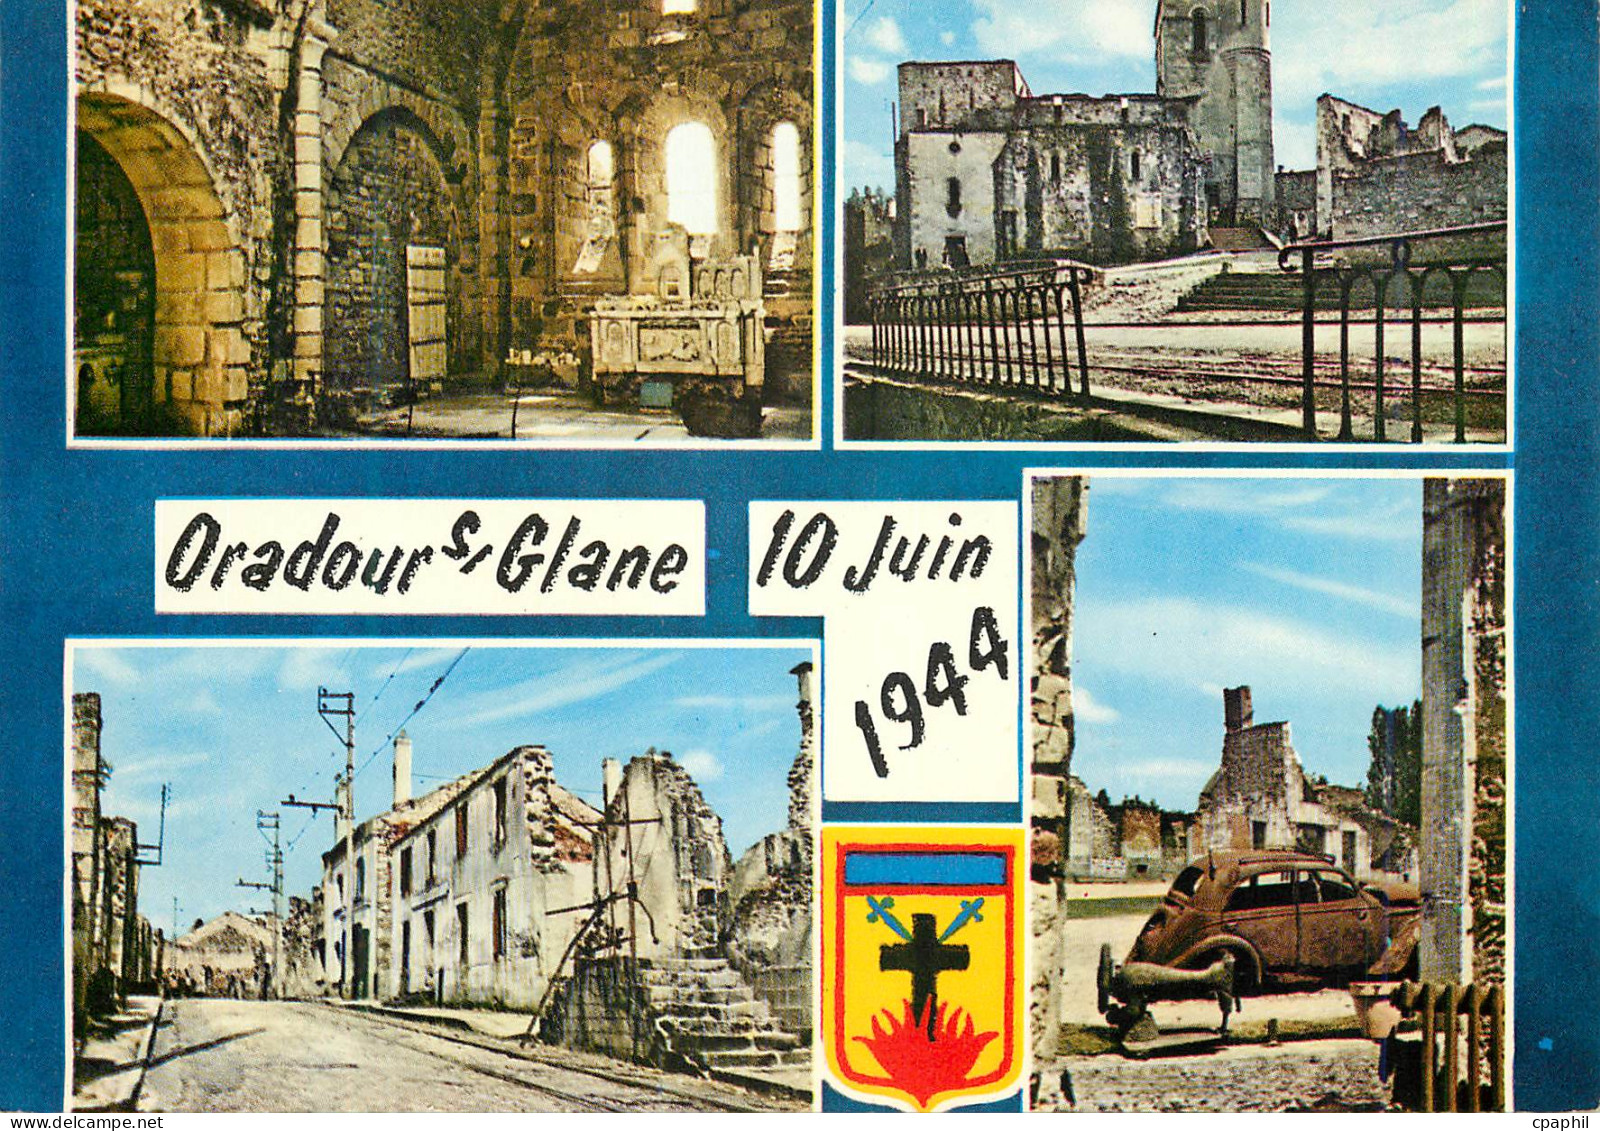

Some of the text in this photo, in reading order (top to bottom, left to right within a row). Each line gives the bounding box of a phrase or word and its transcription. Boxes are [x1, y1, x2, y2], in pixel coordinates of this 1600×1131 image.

[165, 512, 434, 596] Oradour
[496, 513, 689, 594] Glane
[756, 509, 993, 597] 10 Juin
[854, 606, 1009, 779] 1944
